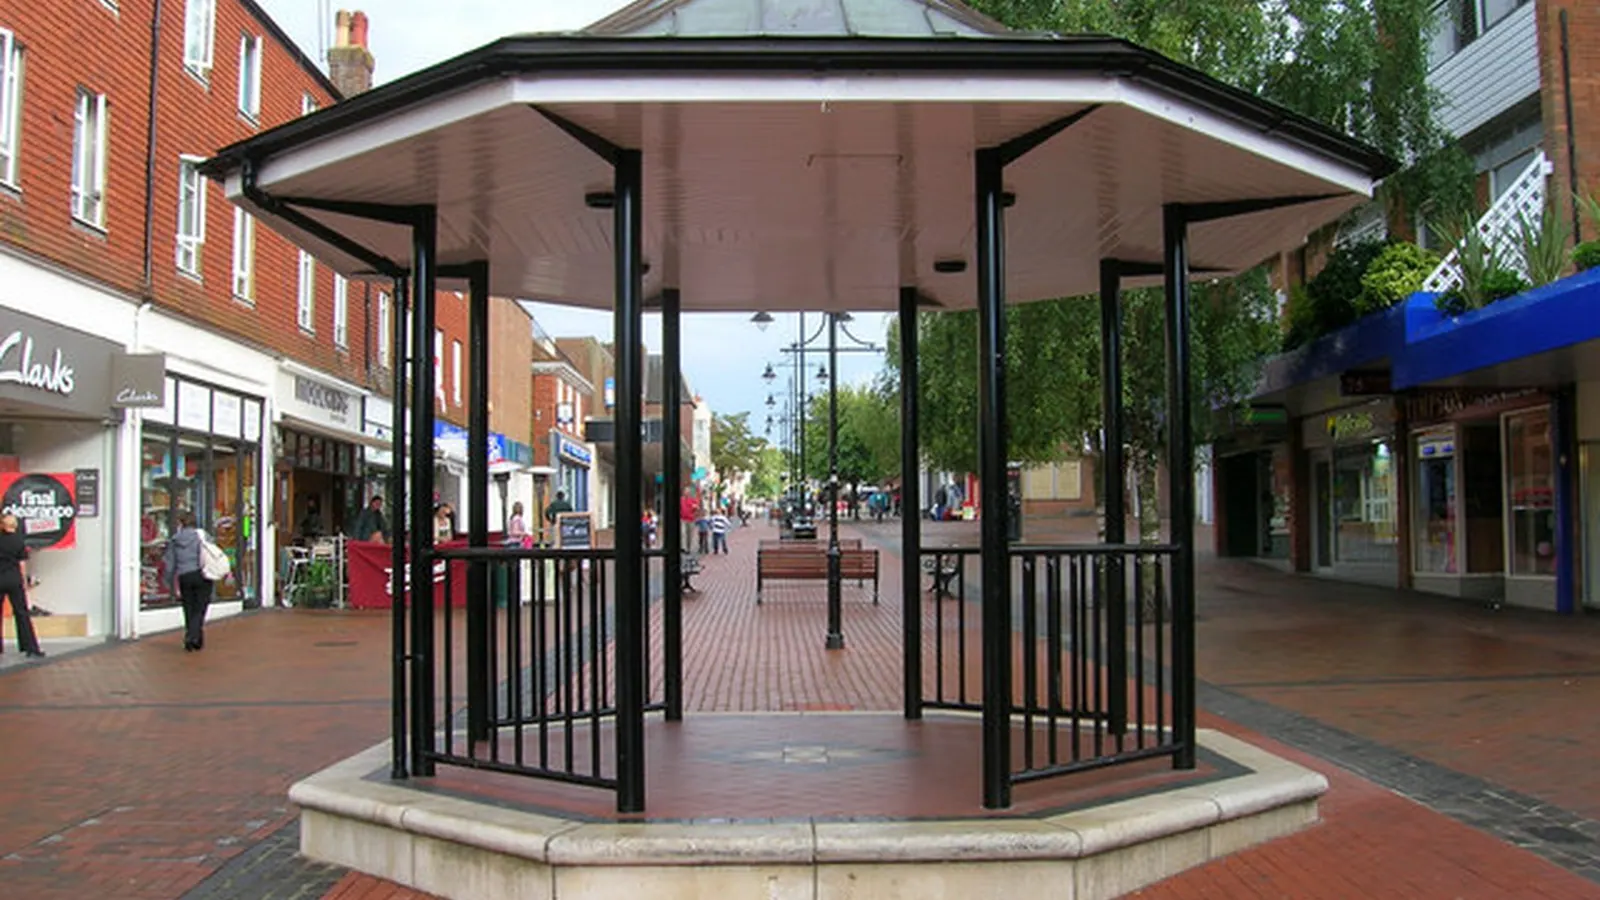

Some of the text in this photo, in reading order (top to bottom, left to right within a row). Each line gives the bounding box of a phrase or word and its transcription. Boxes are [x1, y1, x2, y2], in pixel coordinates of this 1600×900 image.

[0, 331, 75, 394] Clarks
[116, 387, 159, 403] Clarks
[21, 489, 57, 505] final
[2, 503, 75, 519] clearance
